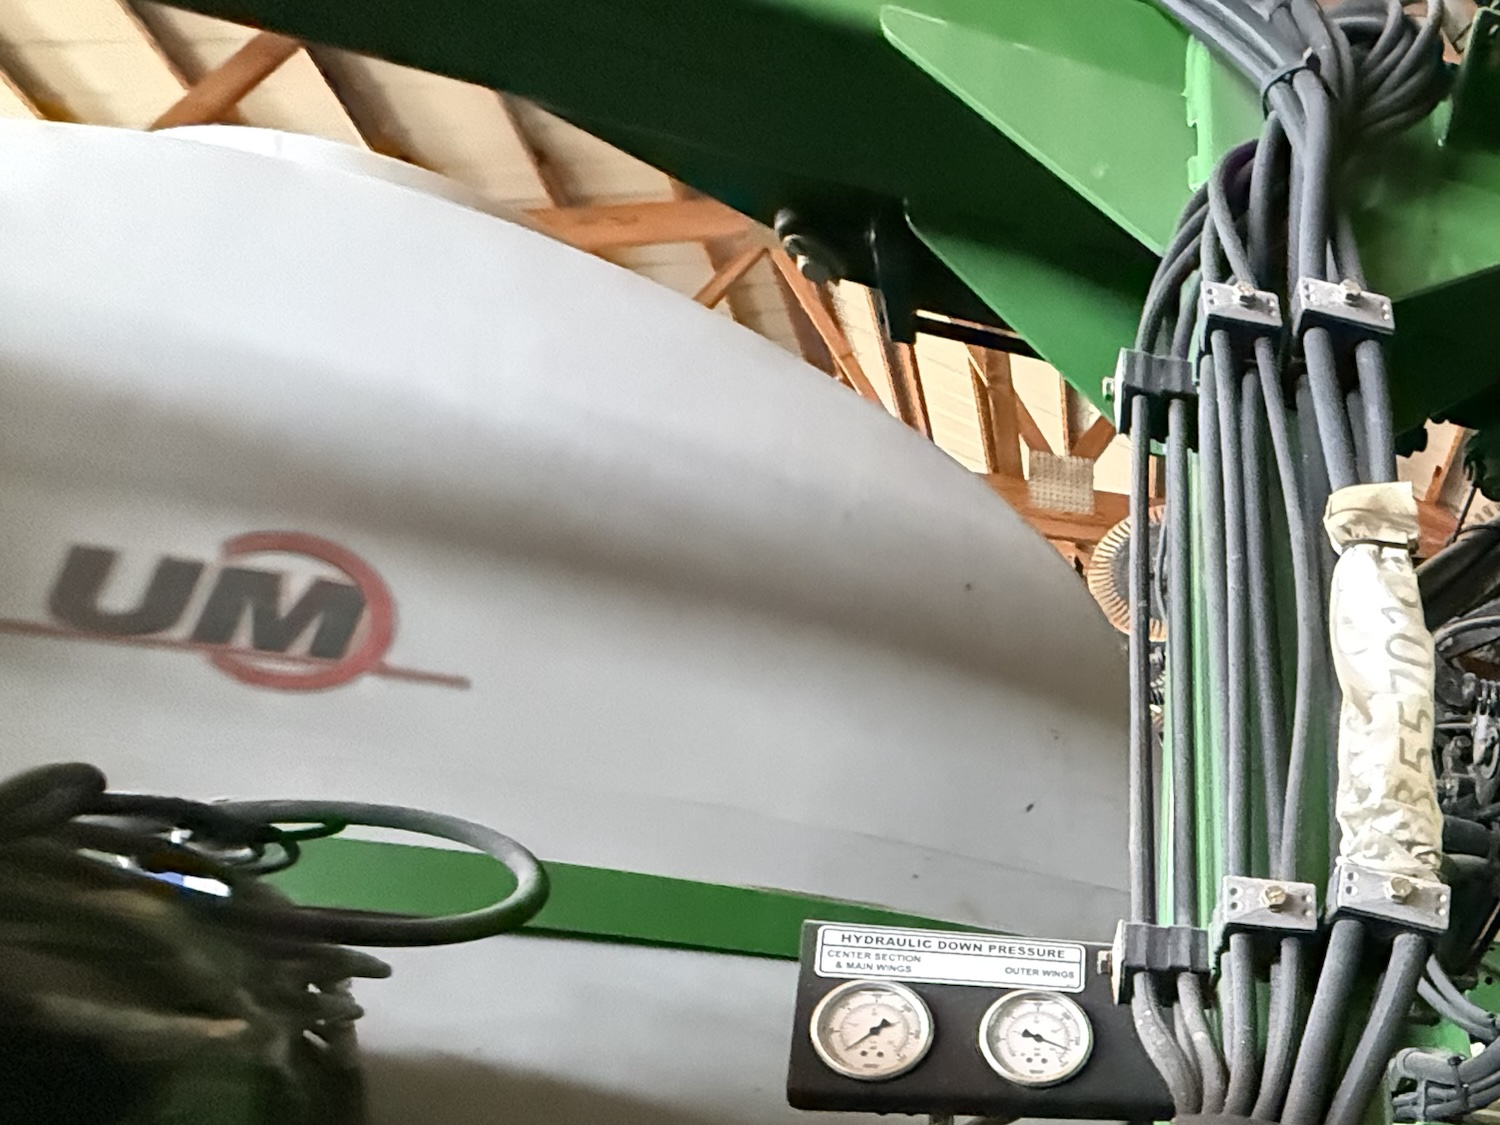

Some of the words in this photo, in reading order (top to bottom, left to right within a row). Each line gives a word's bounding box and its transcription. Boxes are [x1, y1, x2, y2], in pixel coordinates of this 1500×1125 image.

[48, 543, 367, 661] UM
[841, 933, 932, 949] HYDRAULIC
[938, 940, 983, 952] DOWN
[989, 944, 1066, 959] PRESSURE
[827, 949, 872, 960] CENTER
[874, 952, 921, 963] SECTION
[835, 961, 843, 969] &
[846, 961, 874, 971] MAIN
[876, 963, 912, 973] WINGS
[1004, 966, 1040, 977] OUTER
[1042, 969, 1075, 979] WINGS
